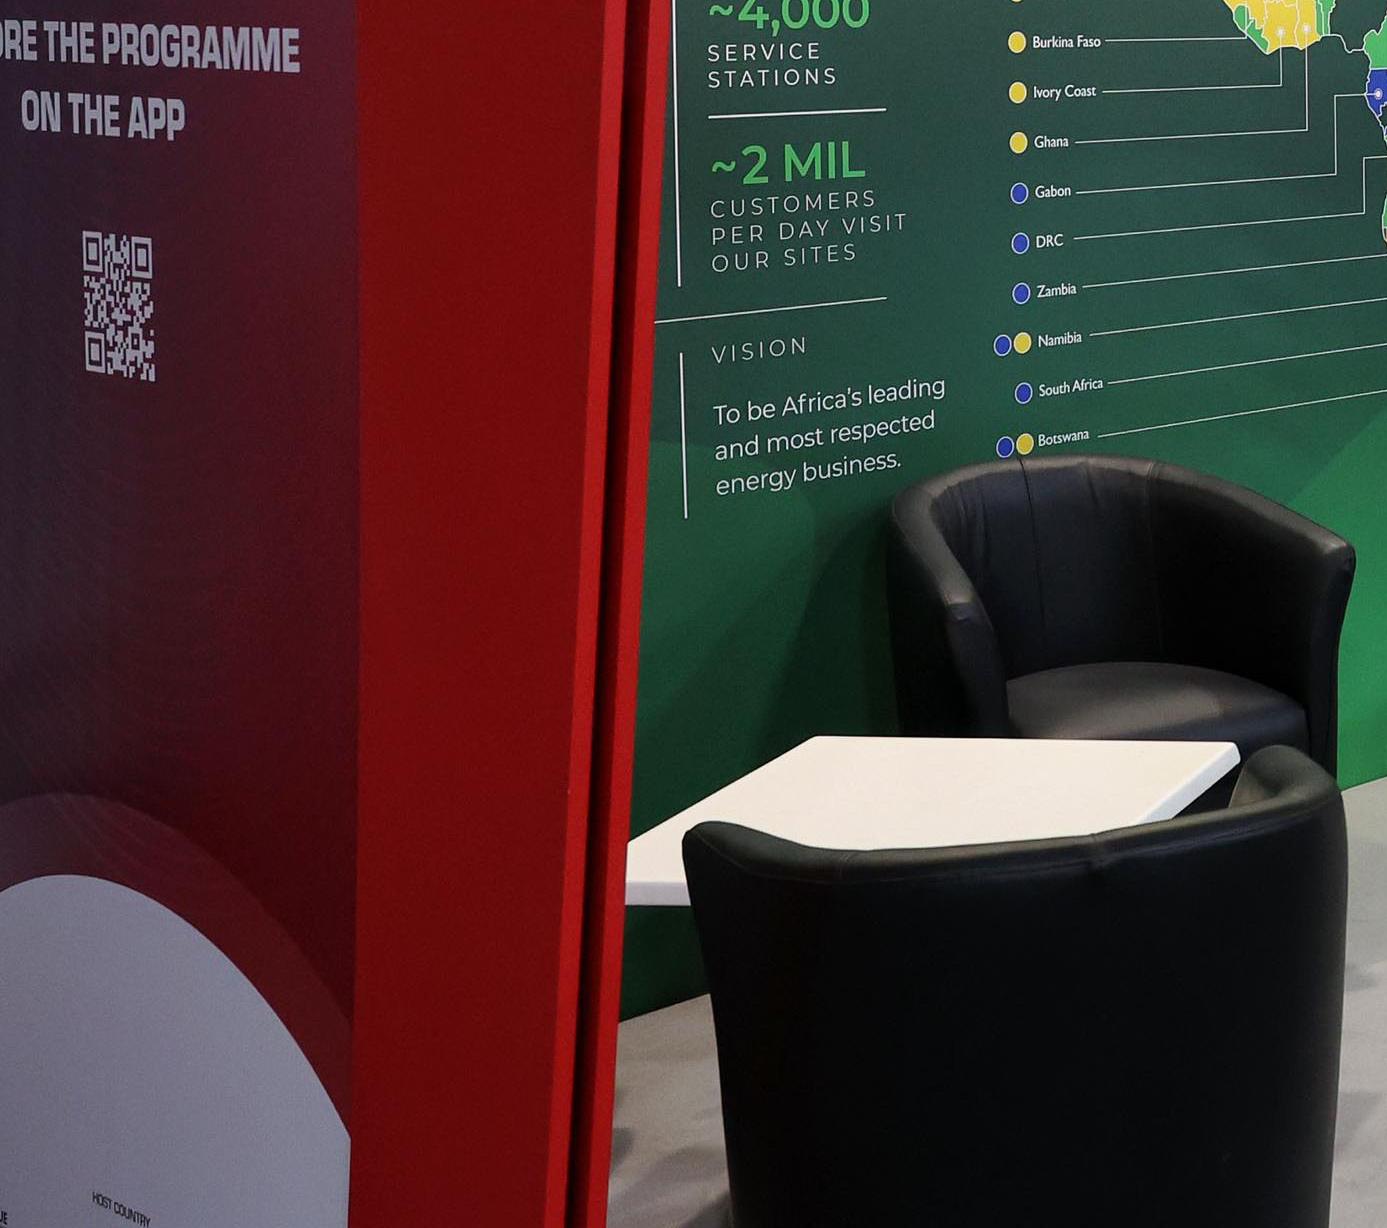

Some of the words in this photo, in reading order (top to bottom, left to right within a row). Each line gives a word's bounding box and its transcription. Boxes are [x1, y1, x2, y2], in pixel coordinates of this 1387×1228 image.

[0, 20, 38, 61] RE
[43, 20, 96, 64] THE
[102, 22, 301, 73] PROGRAMME
[707, 42, 820, 62] SERVICE
[1032, 35, 1073, 48] Burkina
[1077, 35, 1101, 48] Faso
[708, 67, 836, 88] STATIONS
[1033, 85, 1061, 102] Ivory
[1064, 84, 1096, 98] Coast
[21, 90, 61, 133] ON
[67, 92, 120, 137] THE
[128, 96, 185, 141] APP
[1034, 135, 1069, 149] Ghana
[711, 145, 769, 185] ~2
[784, 141, 866, 182] MIL
[1035, 185, 1071, 199] Gabon
[710, 190, 875, 219] CUSTOMERS
[711, 224, 764, 246] PER
[779, 219, 829, 241] DAY
[842, 213, 907, 235] VISIT
[1036, 233, 1064, 249] DRC
[711, 251, 769, 273] OUR
[784, 243, 857, 267] SITES
[1037, 283, 1077, 299] Zambia
[711, 336, 807, 364] VISION
[1038, 332, 1082, 348] Namibia
[1038, 382, 1070, 397] South
[1072, 378, 1103, 393] Africa
[713, 404, 741, 425] To
[747, 399, 776, 421] be
[782, 388, 863, 419] Africa's
[868, 378, 945, 405] leading
[715, 434, 759, 461] and
[767, 428, 824, 453] most
[830, 409, 936, 445] respected
[1038, 429, 1089, 447] Botswana
[716, 465, 796, 496] energy
[803, 452, 901, 483] business.
[92, 1191, 112, 1210] HOST
[114, 1202, 151, 1228] COUNTRY
